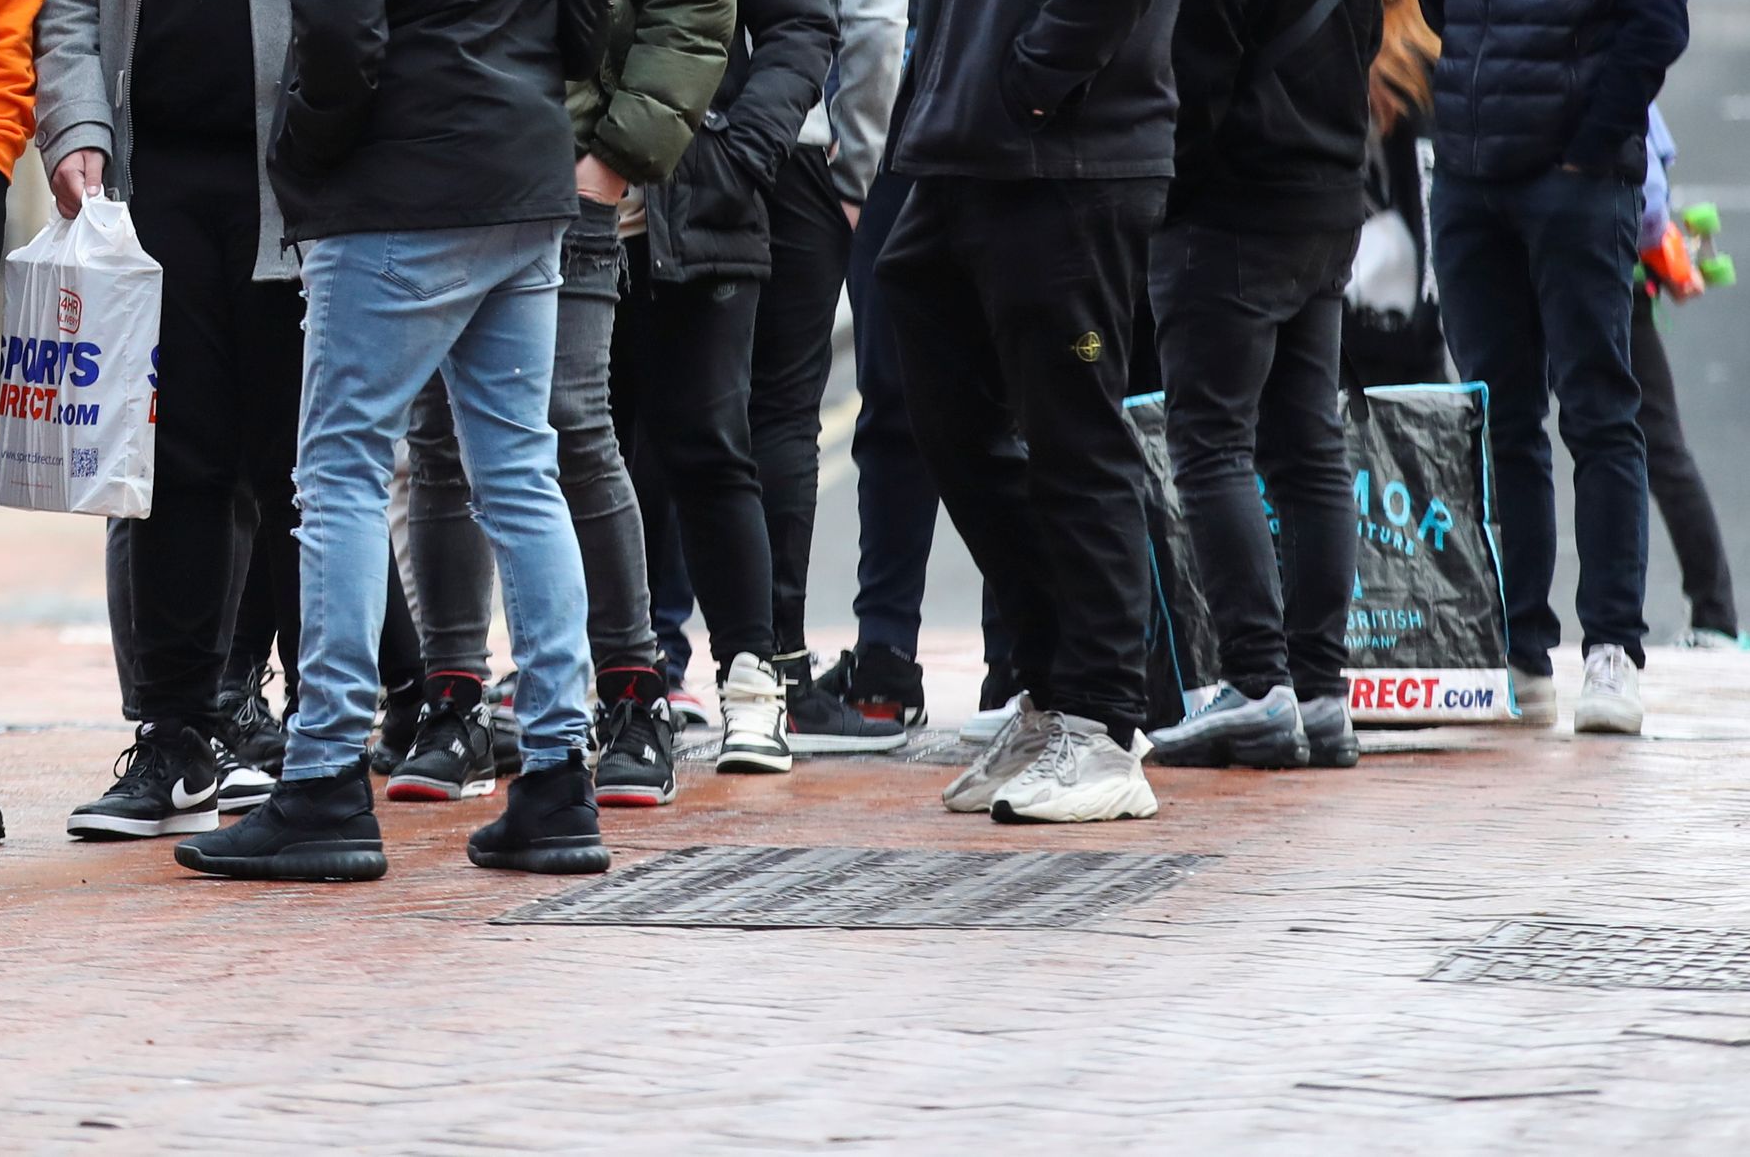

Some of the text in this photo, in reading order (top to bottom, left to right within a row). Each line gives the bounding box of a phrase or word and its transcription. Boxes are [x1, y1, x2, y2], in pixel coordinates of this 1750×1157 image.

[59, 297, 79, 315] 4HR
[1343, 633, 1397, 649] OMPANY
[1348, 677, 1494, 709] RECT.COM
